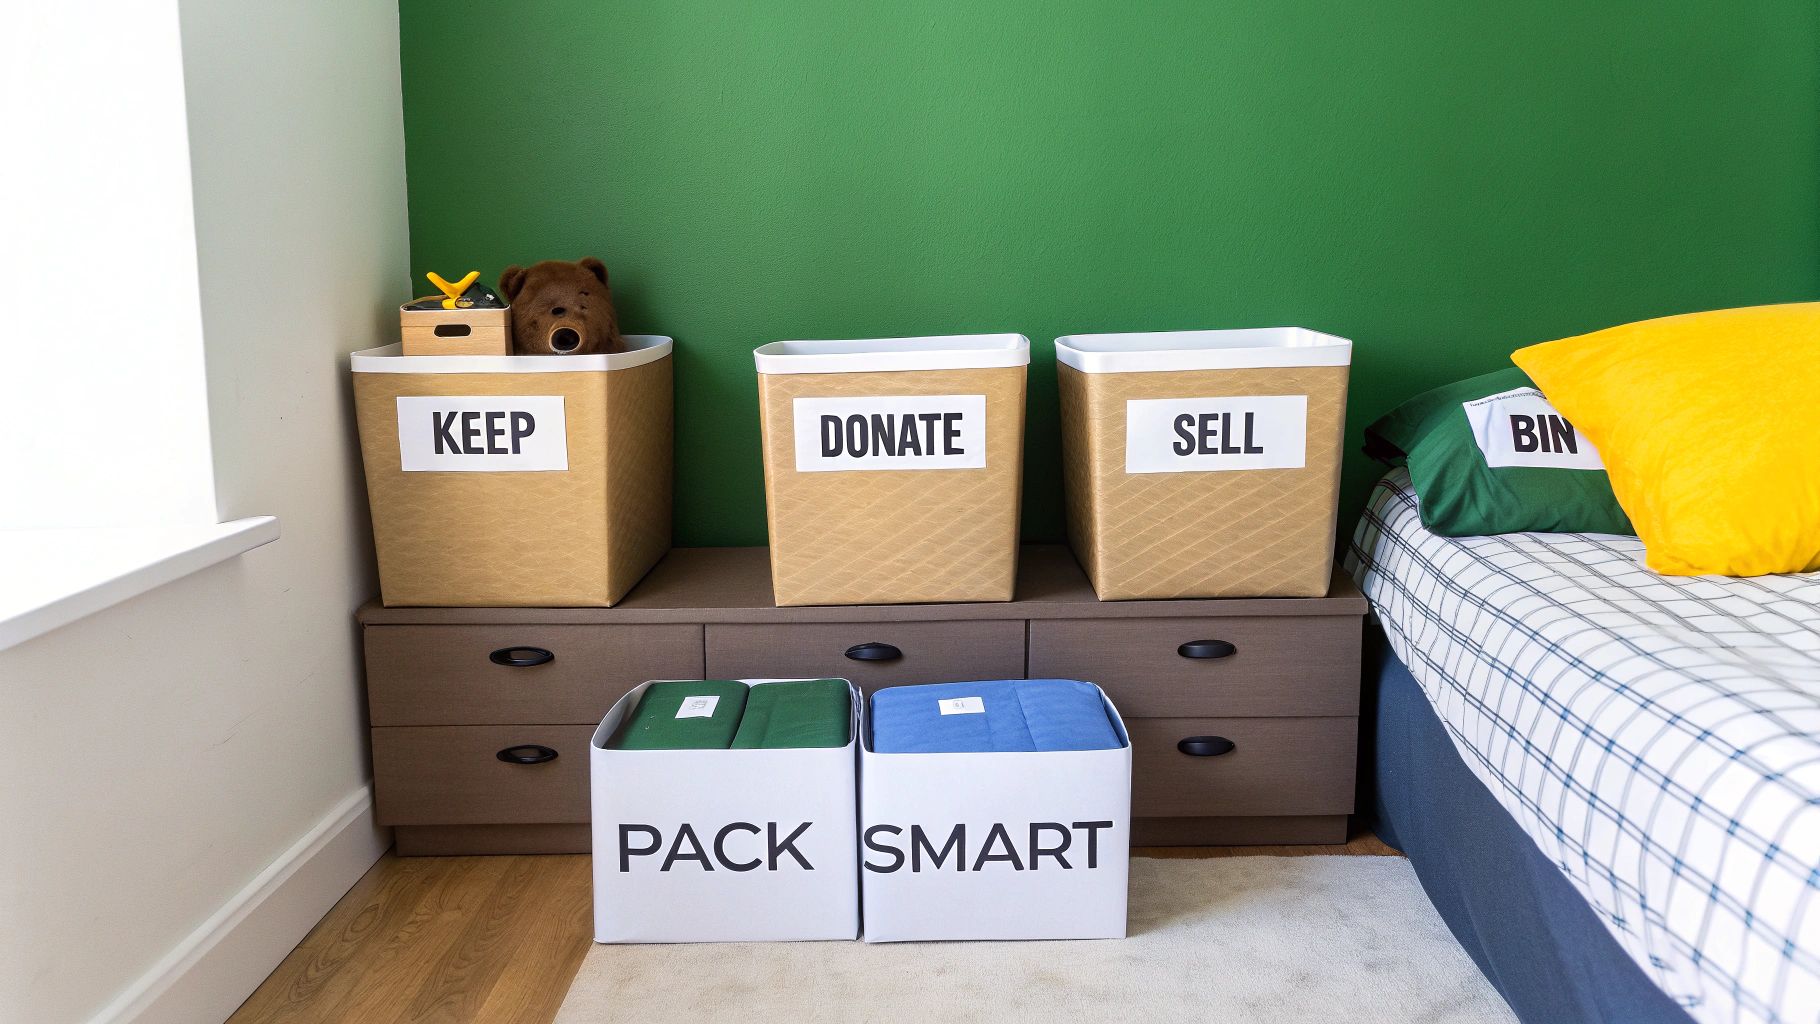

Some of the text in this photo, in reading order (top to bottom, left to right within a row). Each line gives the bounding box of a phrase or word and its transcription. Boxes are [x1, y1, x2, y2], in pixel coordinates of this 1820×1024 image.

[433, 412, 535, 454] KEEP
[821, 413, 964, 458] DONATE
[1173, 412, 1264, 456] SELL
[1510, 415, 1578, 454] BIN
[618, 821, 814, 872] PACK
[863, 821, 1113, 874] SMART
